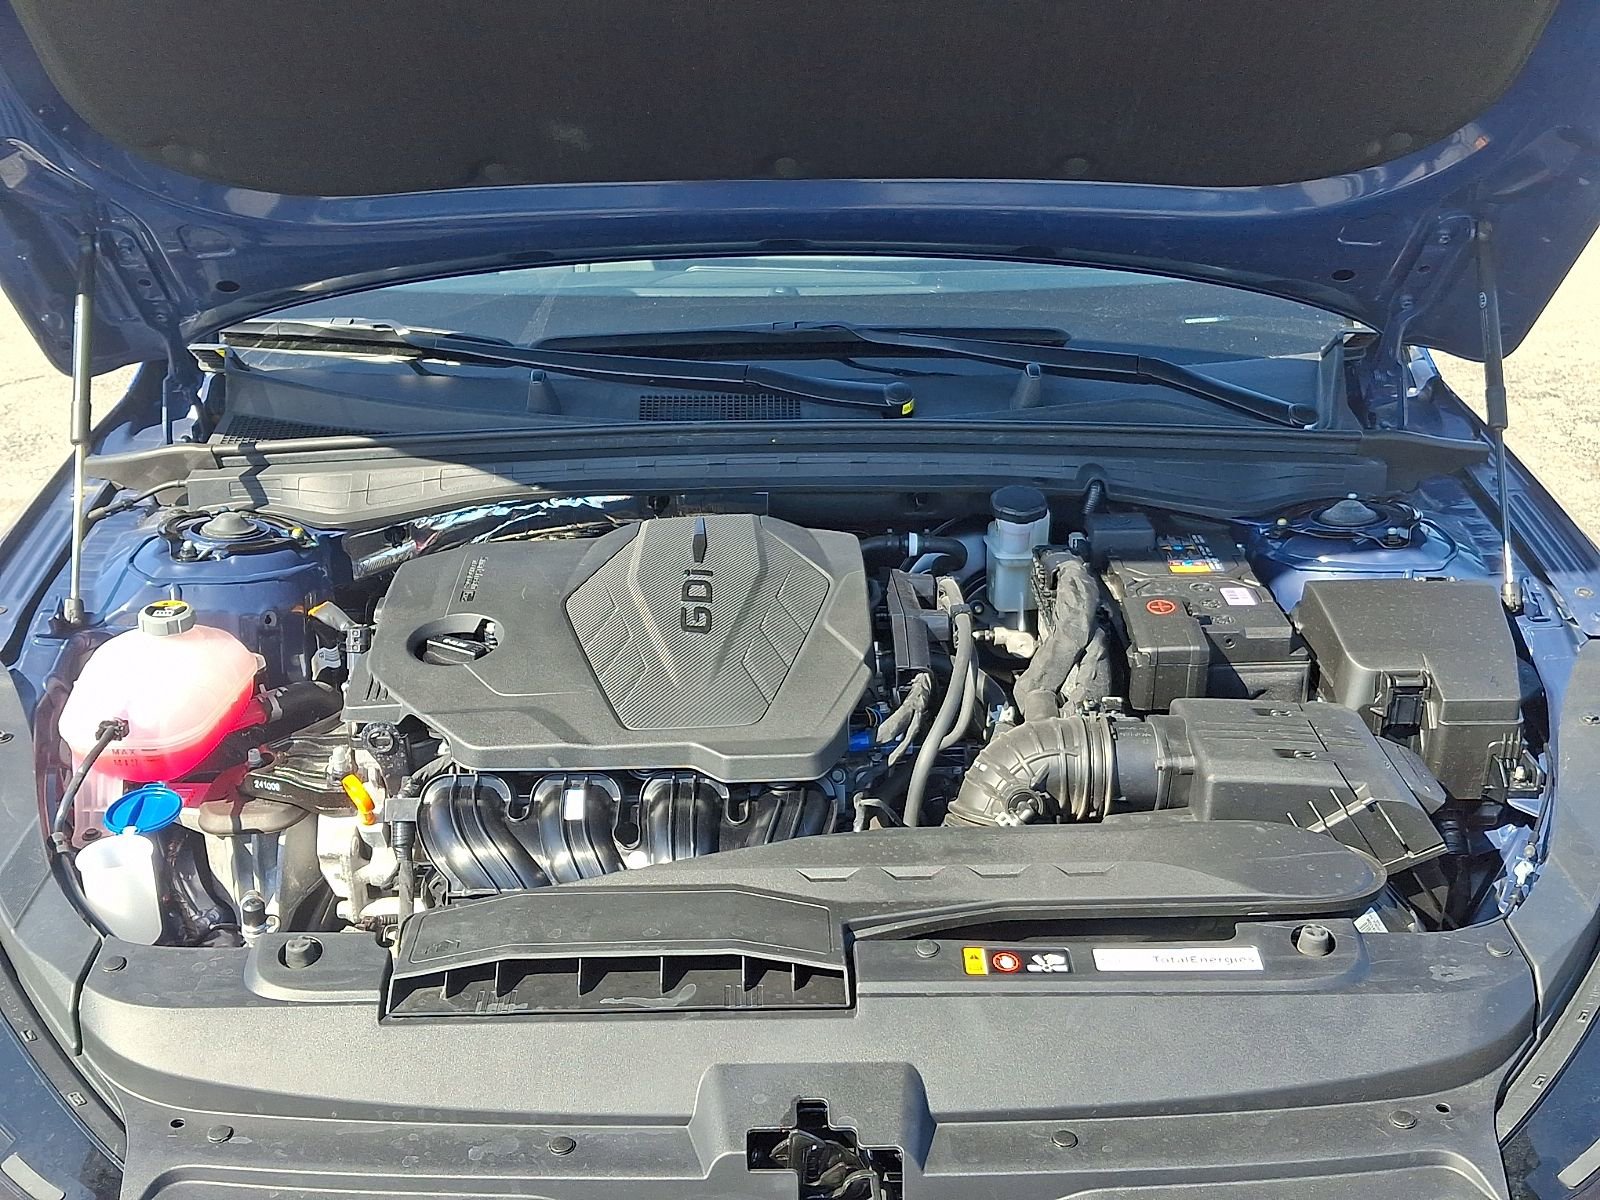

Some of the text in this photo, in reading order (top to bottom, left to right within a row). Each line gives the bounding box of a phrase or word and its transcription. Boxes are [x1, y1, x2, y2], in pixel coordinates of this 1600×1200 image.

[681, 570, 713, 634] GDi
[112, 748, 136, 756] MAX
[1152, 955, 1255, 967] TotalEnergies
